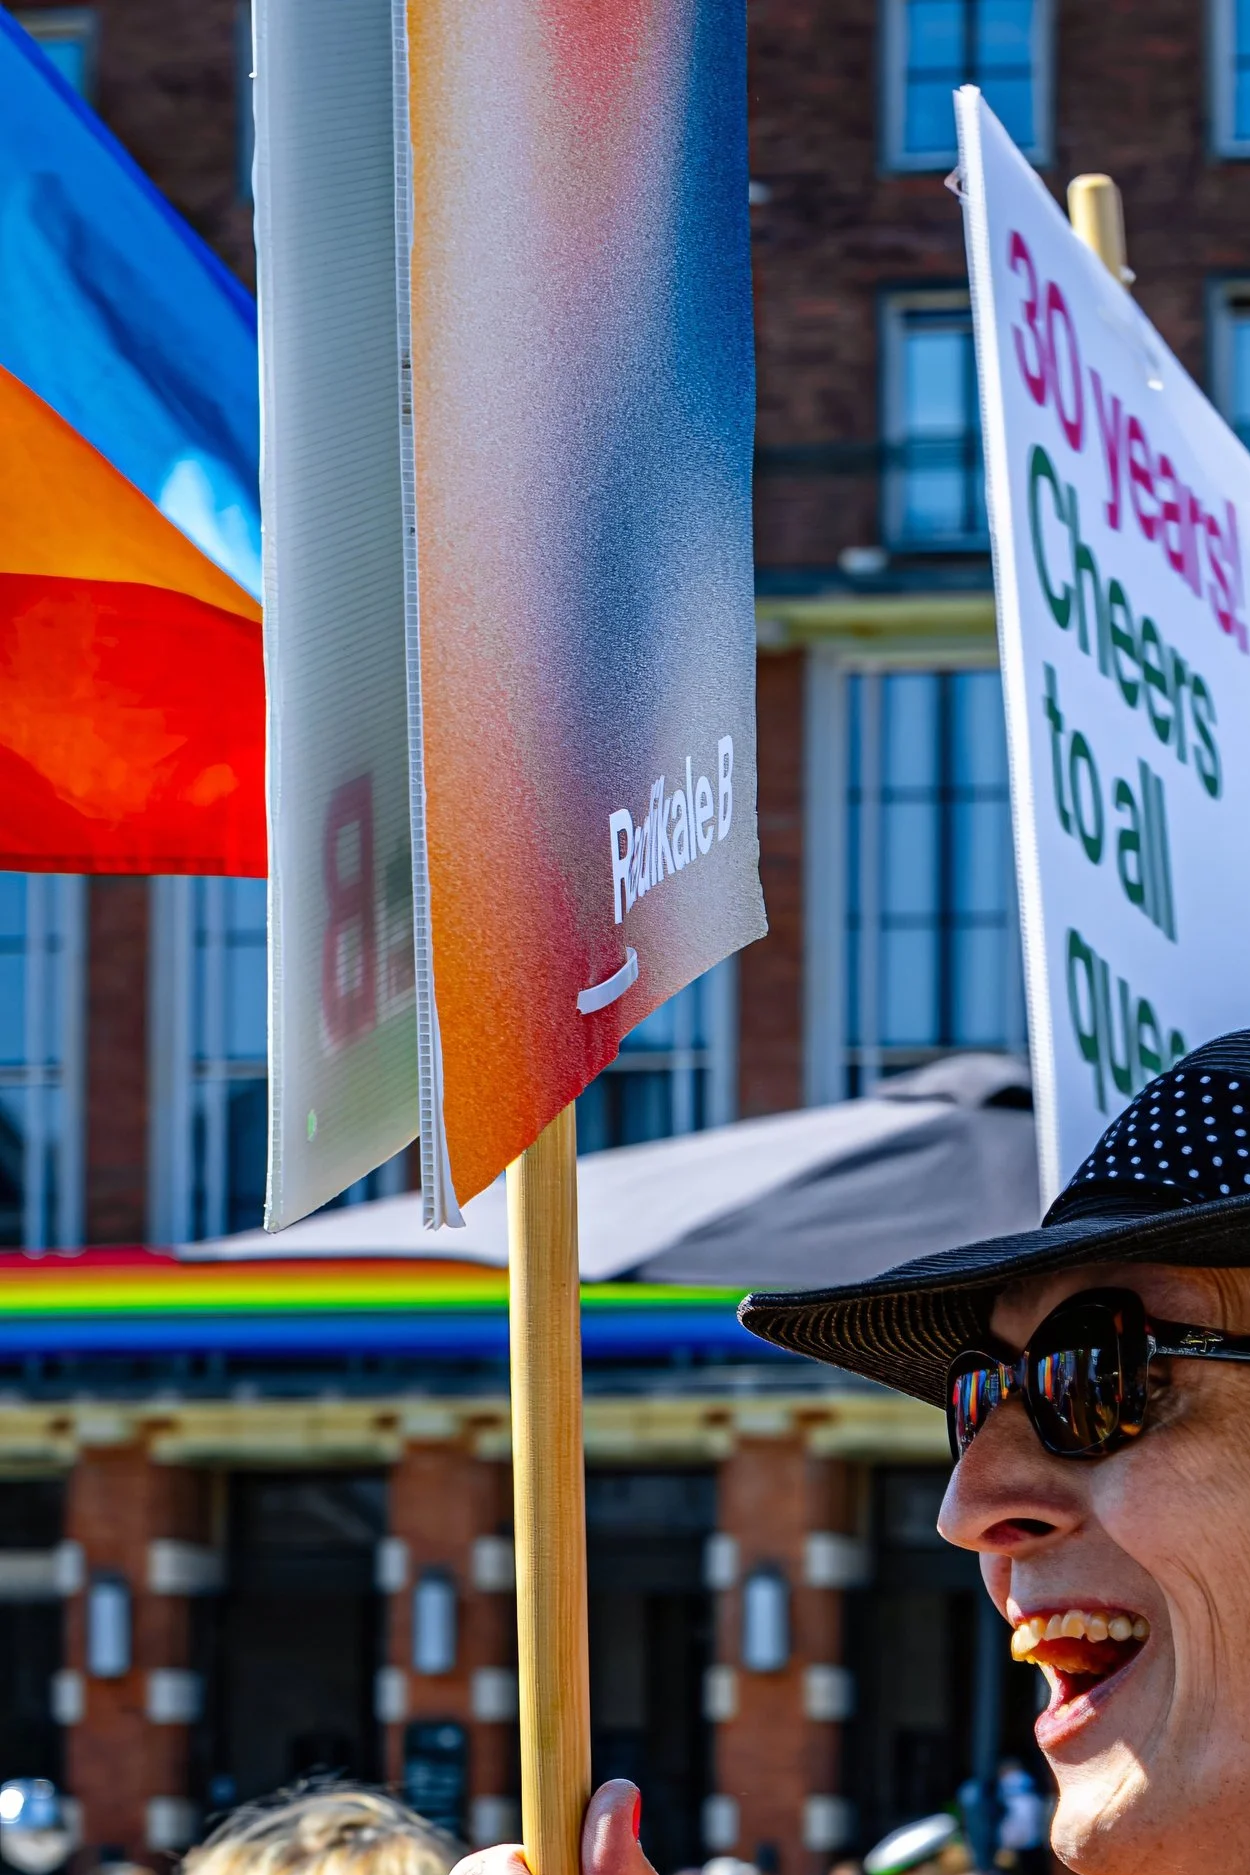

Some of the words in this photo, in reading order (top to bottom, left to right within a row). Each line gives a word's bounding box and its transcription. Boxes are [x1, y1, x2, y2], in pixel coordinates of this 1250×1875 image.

[1008, 230, 1085, 453] 30
[1088, 366, 1250, 656] years!
[1028, 443, 1223, 800] Cheers
[718, 735, 733, 841] B
[1042, 660, 1105, 866] to
[1112, 756, 1178, 944] all
